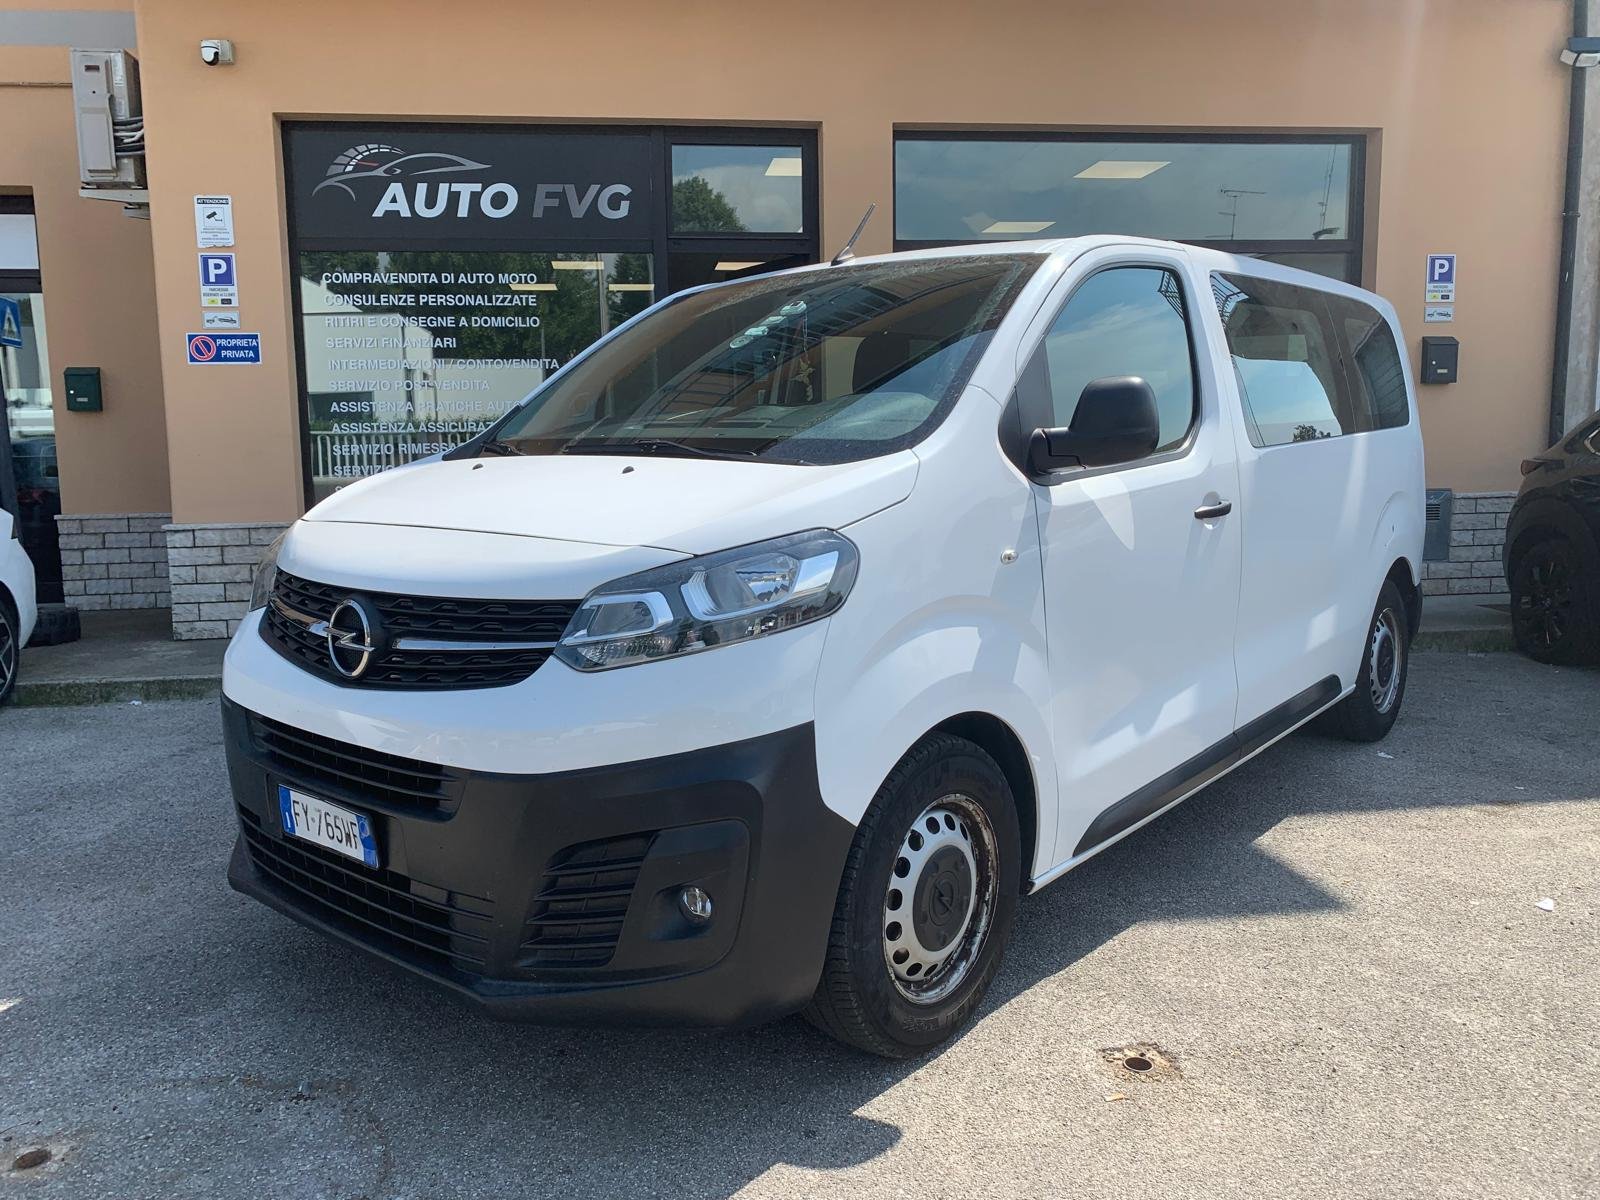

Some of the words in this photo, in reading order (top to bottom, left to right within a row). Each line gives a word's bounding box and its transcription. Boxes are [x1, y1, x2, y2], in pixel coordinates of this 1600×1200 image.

[371, 182, 519, 219] AUTO
[531, 183, 633, 219] FVG
[208, 258, 227, 283] P
[1434, 259, 1449, 281] P
[321, 272, 438, 284] COMPRAVENDITA
[441, 273, 455, 284] DI
[457, 273, 495, 285] AUTO
[498, 273, 537, 285] MOTO
[325, 294, 416, 306] CONSULENZE
[419, 294, 537, 306] PERSONALIZZATE
[325, 316, 365, 328] RITIRI
[368, 316, 377, 328] E
[380, 316, 456, 328] CONSEGNE
[459, 316, 469, 327] A
[471, 316, 540, 328] DOMICILIO
[326, 337, 379, 349] SERVIZI
[382, 337, 457, 348] FINANZIARI
[221, 350, 255, 359] PRIVATA
[328, 358, 445, 371] INTERMEDIAZIONI
[457, 358, 560, 370] CONTOVENDITA
[328, 380, 391, 392] SERVIZIO
[330, 401, 414, 413] ASSISTENZA
[418, 401, 484, 412] PRATICHE
[487, 400, 518, 411] AUT
[332, 422, 415, 434] ASSISTENZA
[333, 443, 395, 456] SERVIZIO
